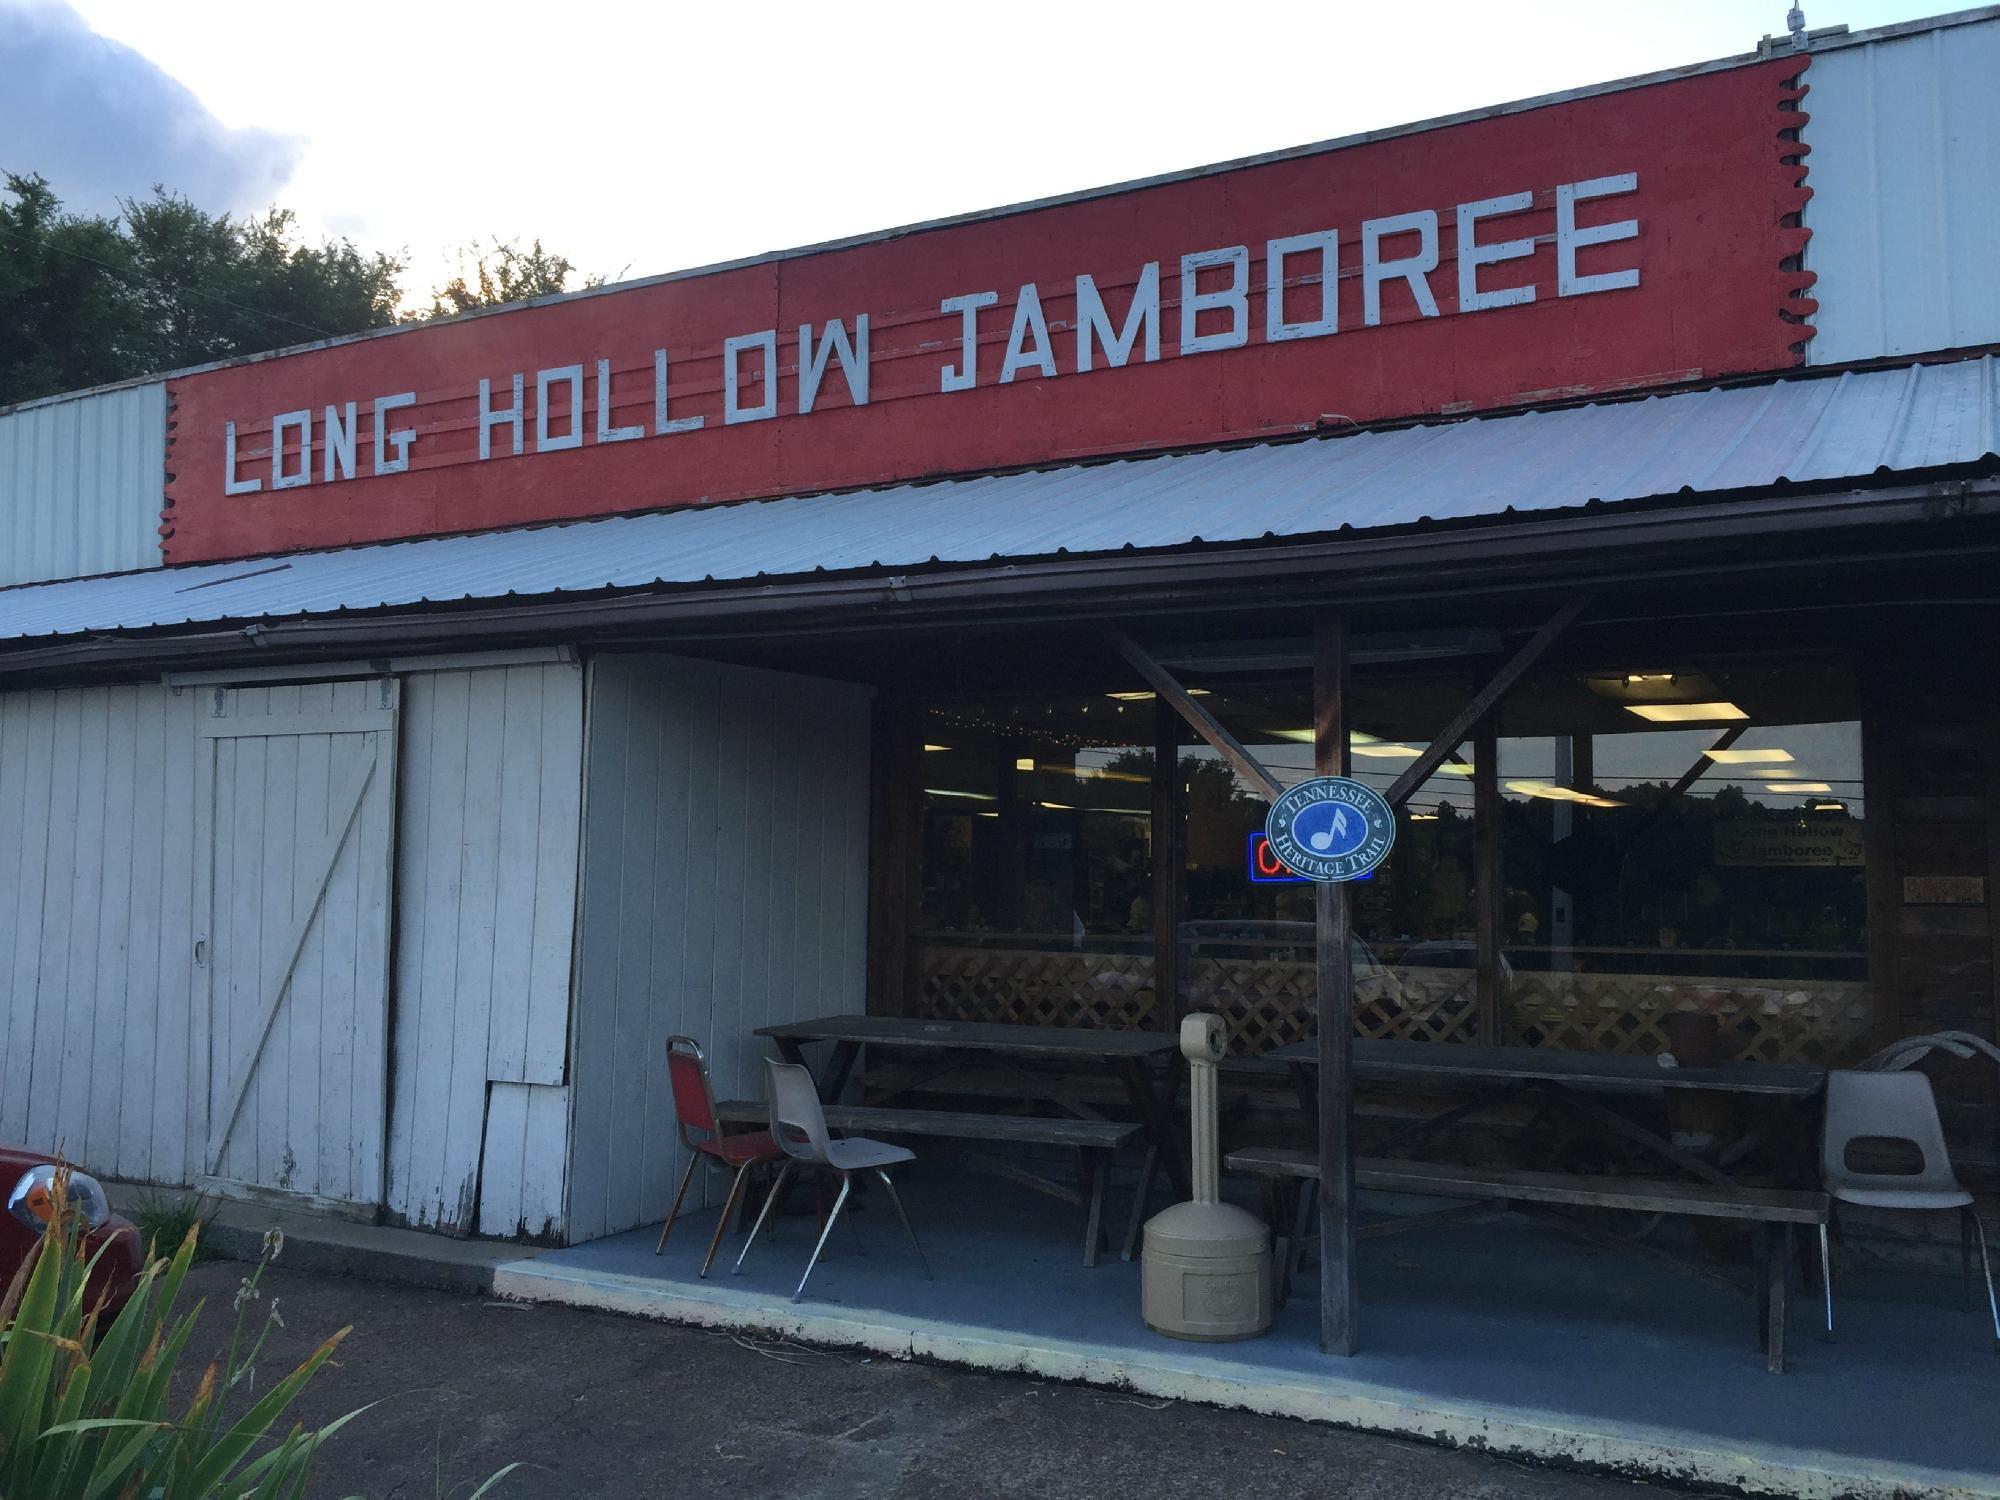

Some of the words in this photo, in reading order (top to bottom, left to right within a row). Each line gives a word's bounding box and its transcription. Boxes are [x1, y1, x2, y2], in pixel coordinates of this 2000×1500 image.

[225, 391, 417, 495] LONG
[478, 313, 869, 460] HOLLOW
[940, 172, 1639, 393] JAMBOREE
[1282, 785, 1375, 814] TENNESSEE
[1275, 832, 1345, 874] HERITAGE
[1345, 835, 1386, 871] TRAIL
